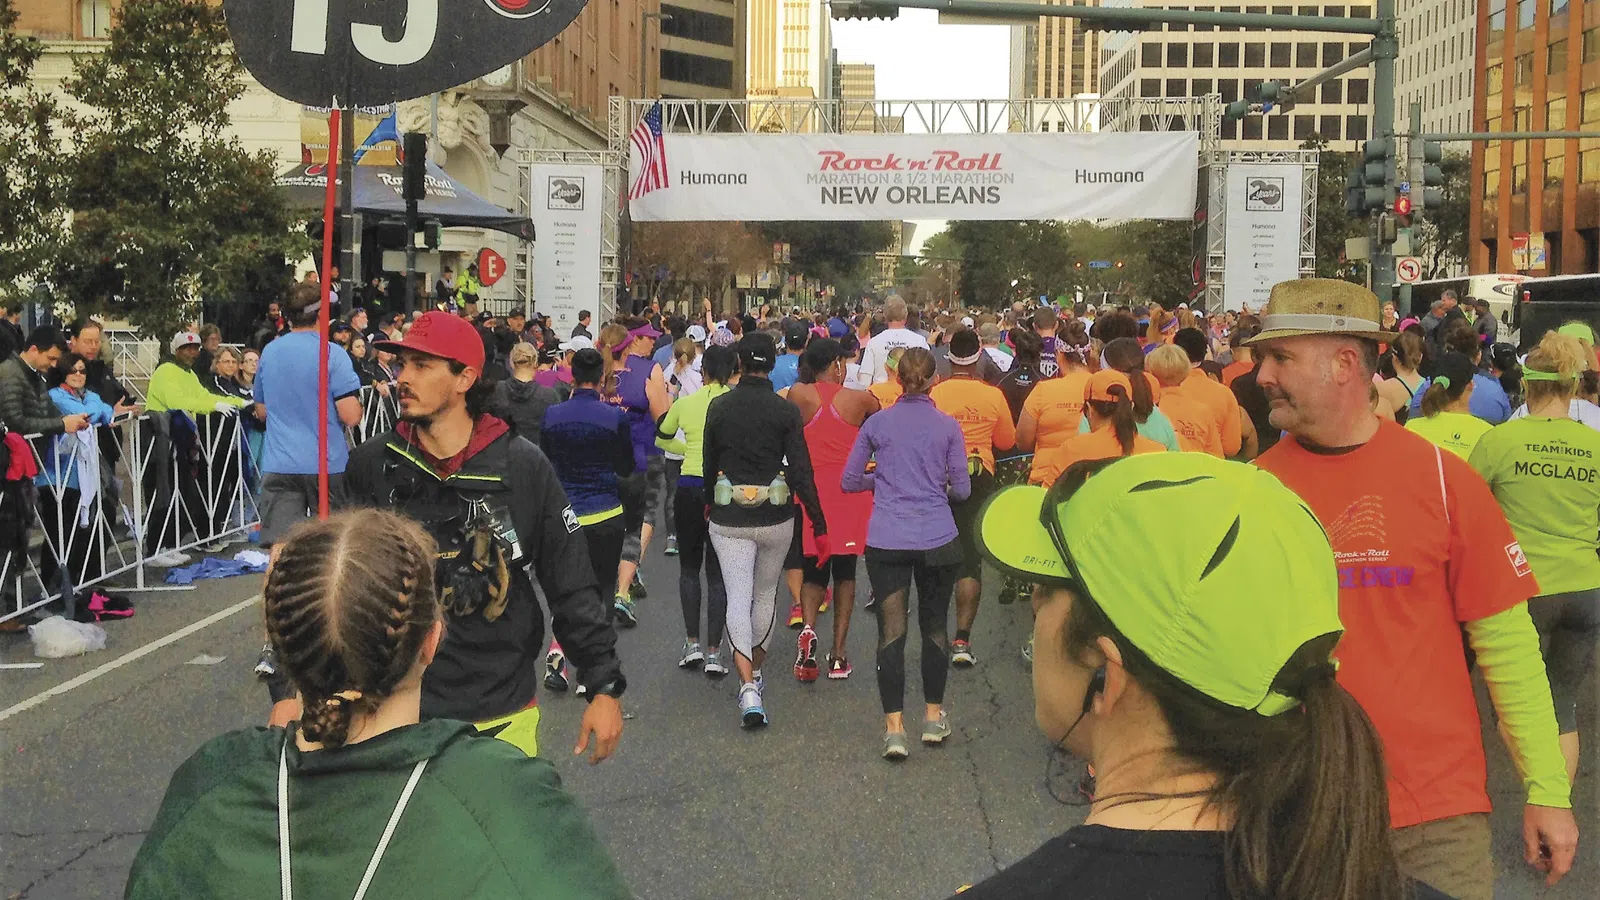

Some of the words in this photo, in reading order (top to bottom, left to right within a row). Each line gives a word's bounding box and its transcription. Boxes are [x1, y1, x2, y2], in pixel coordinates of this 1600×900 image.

[818, 150, 904, 171] Rock
[932, 150, 1003, 171] Roll
[680, 170, 747, 185] Humana
[806, 173, 889, 184] MARATHON
[893, 173, 903, 184] &
[907, 172, 927, 186] 1/2
[931, 173, 1014, 184] MARATHON
[1075, 169, 1144, 184] Humana
[821, 186, 879, 204] NEW
[886, 186, 1001, 205] ORLEANS
[488, 255, 498, 278] E
[1524, 443, 1560, 455] TEAM
[1564, 446, 1593, 459] KIDS
[1514, 460, 1598, 483] MCGLADE
[1022, 554, 1058, 569] DRI-FIT
[1361, 565, 1415, 588] CREW
